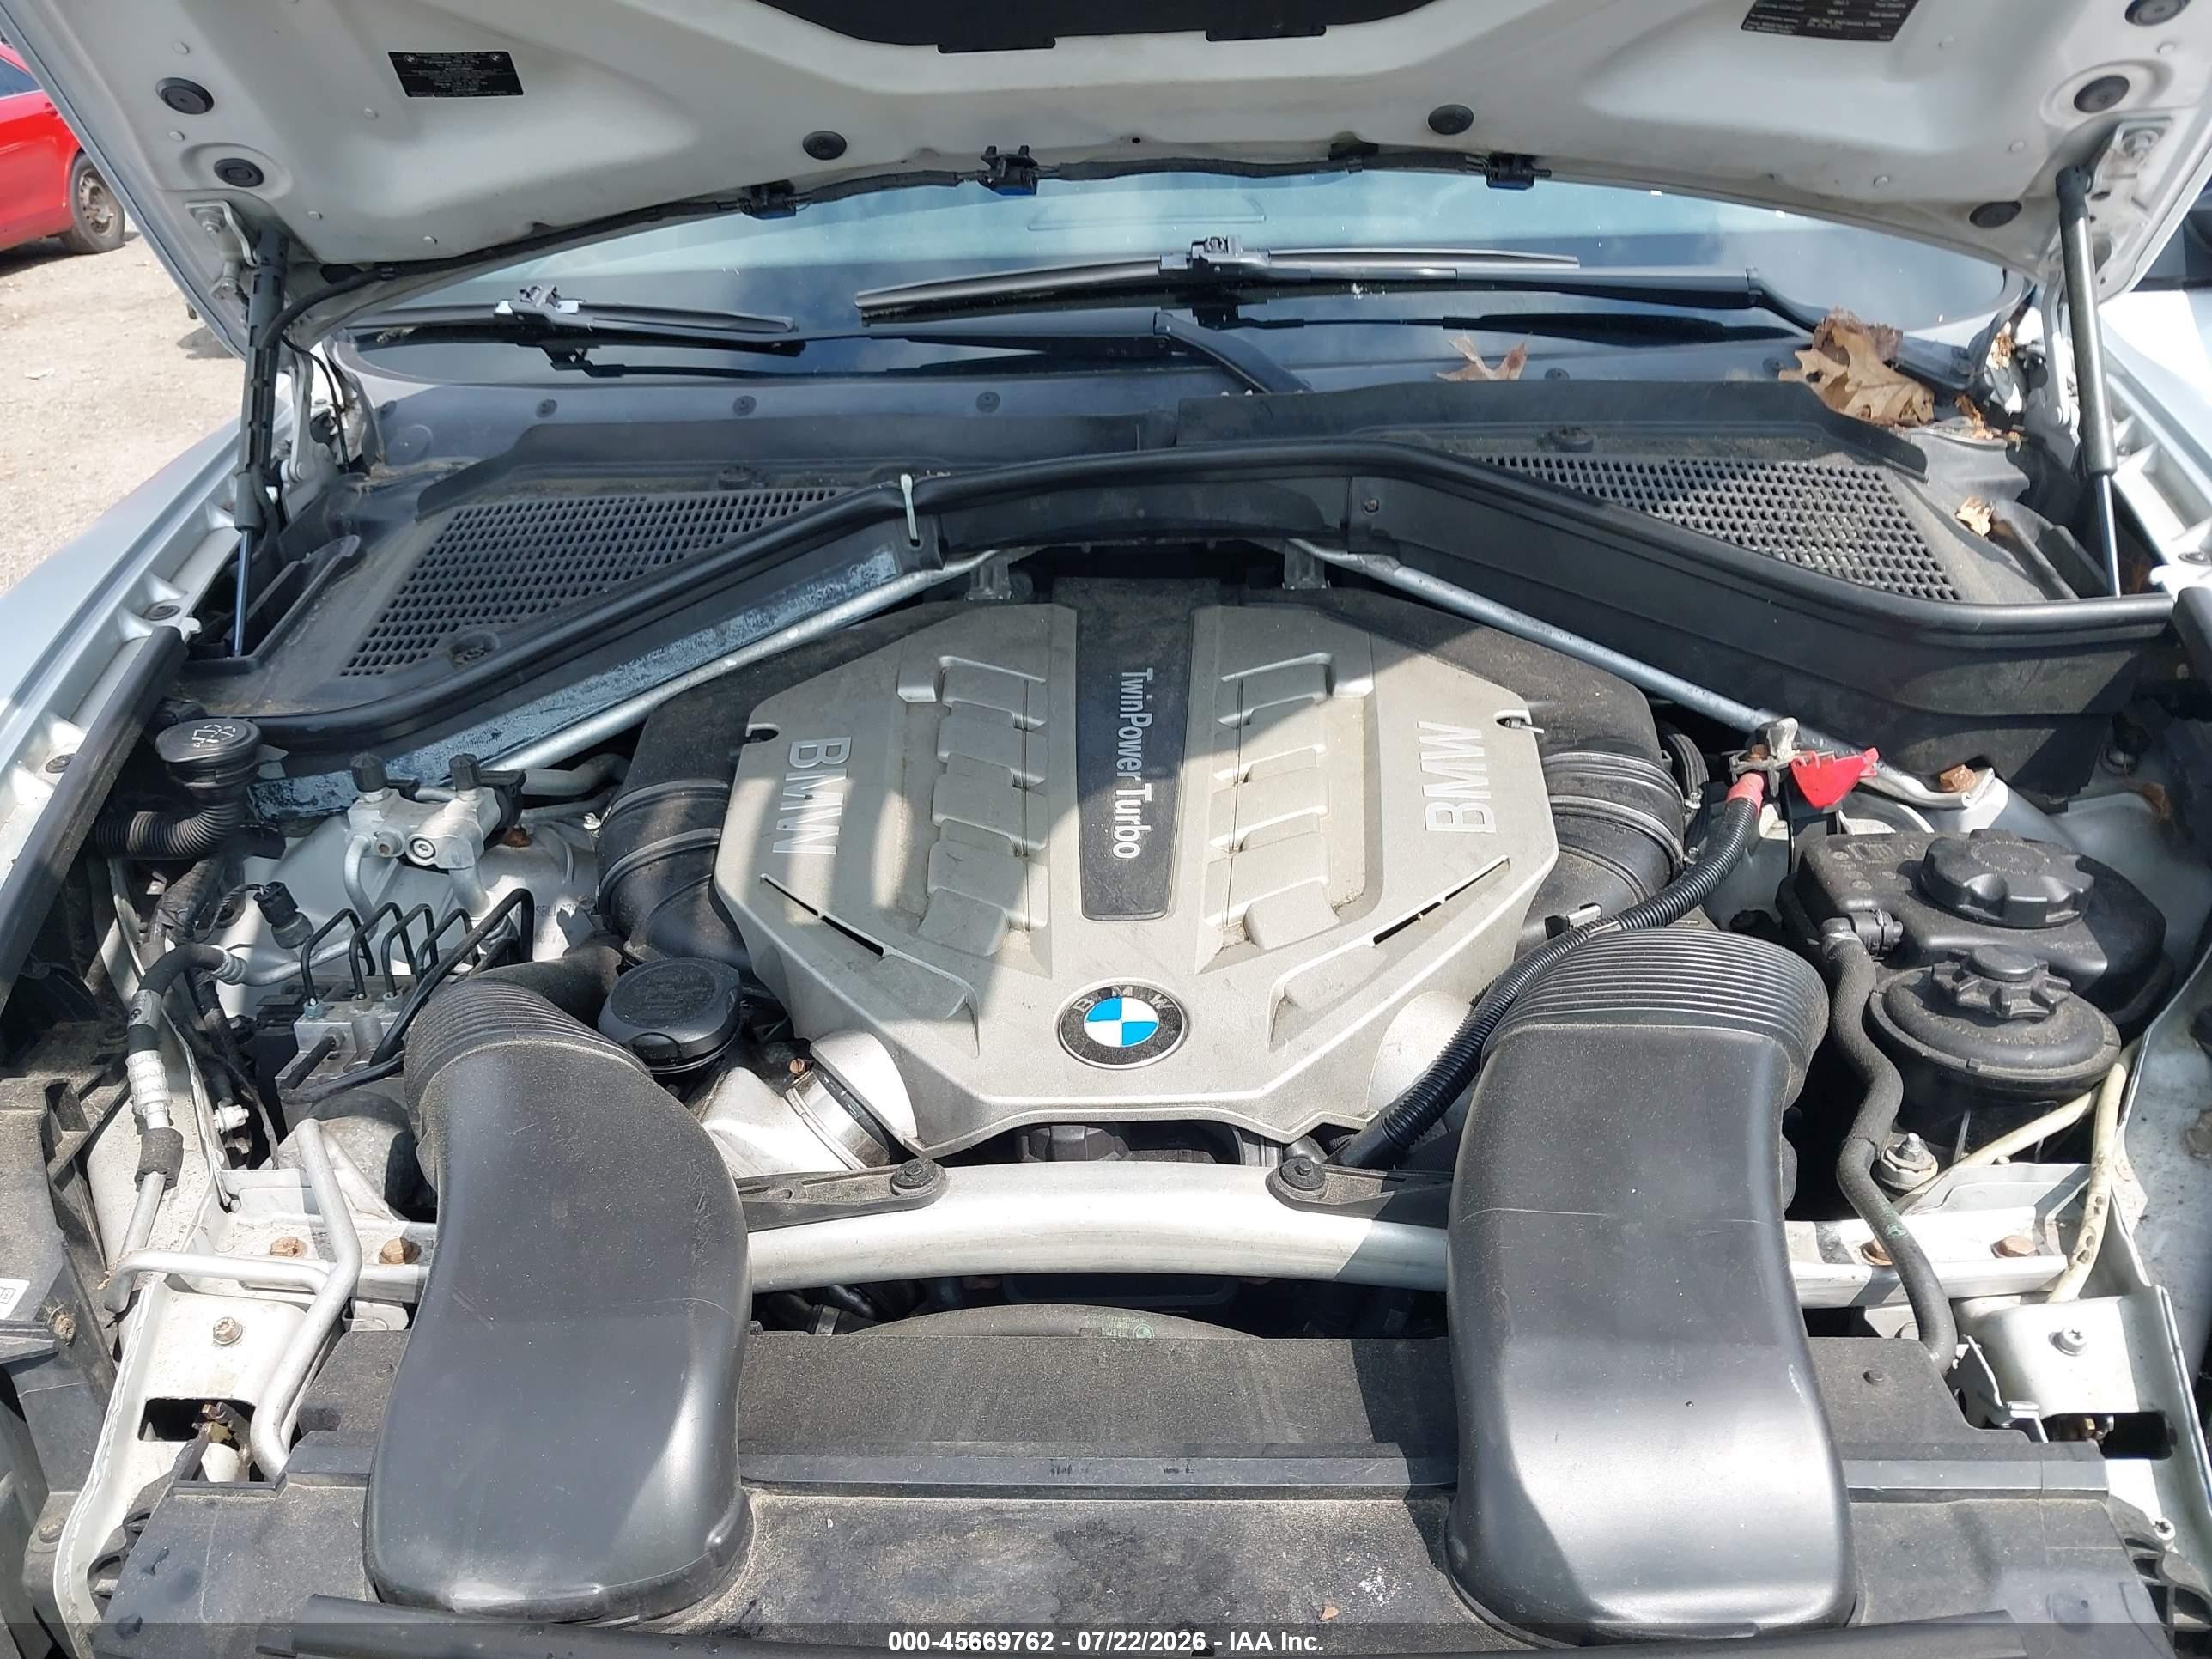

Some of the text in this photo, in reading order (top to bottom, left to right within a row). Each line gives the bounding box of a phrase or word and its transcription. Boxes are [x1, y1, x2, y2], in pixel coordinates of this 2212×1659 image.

[773, 737, 852, 854] BMW
[1113, 667, 1153, 860] TwinPower Turbo
[1416, 720, 1497, 833] BMW
[1073, 985, 1175, 1012] BMW
